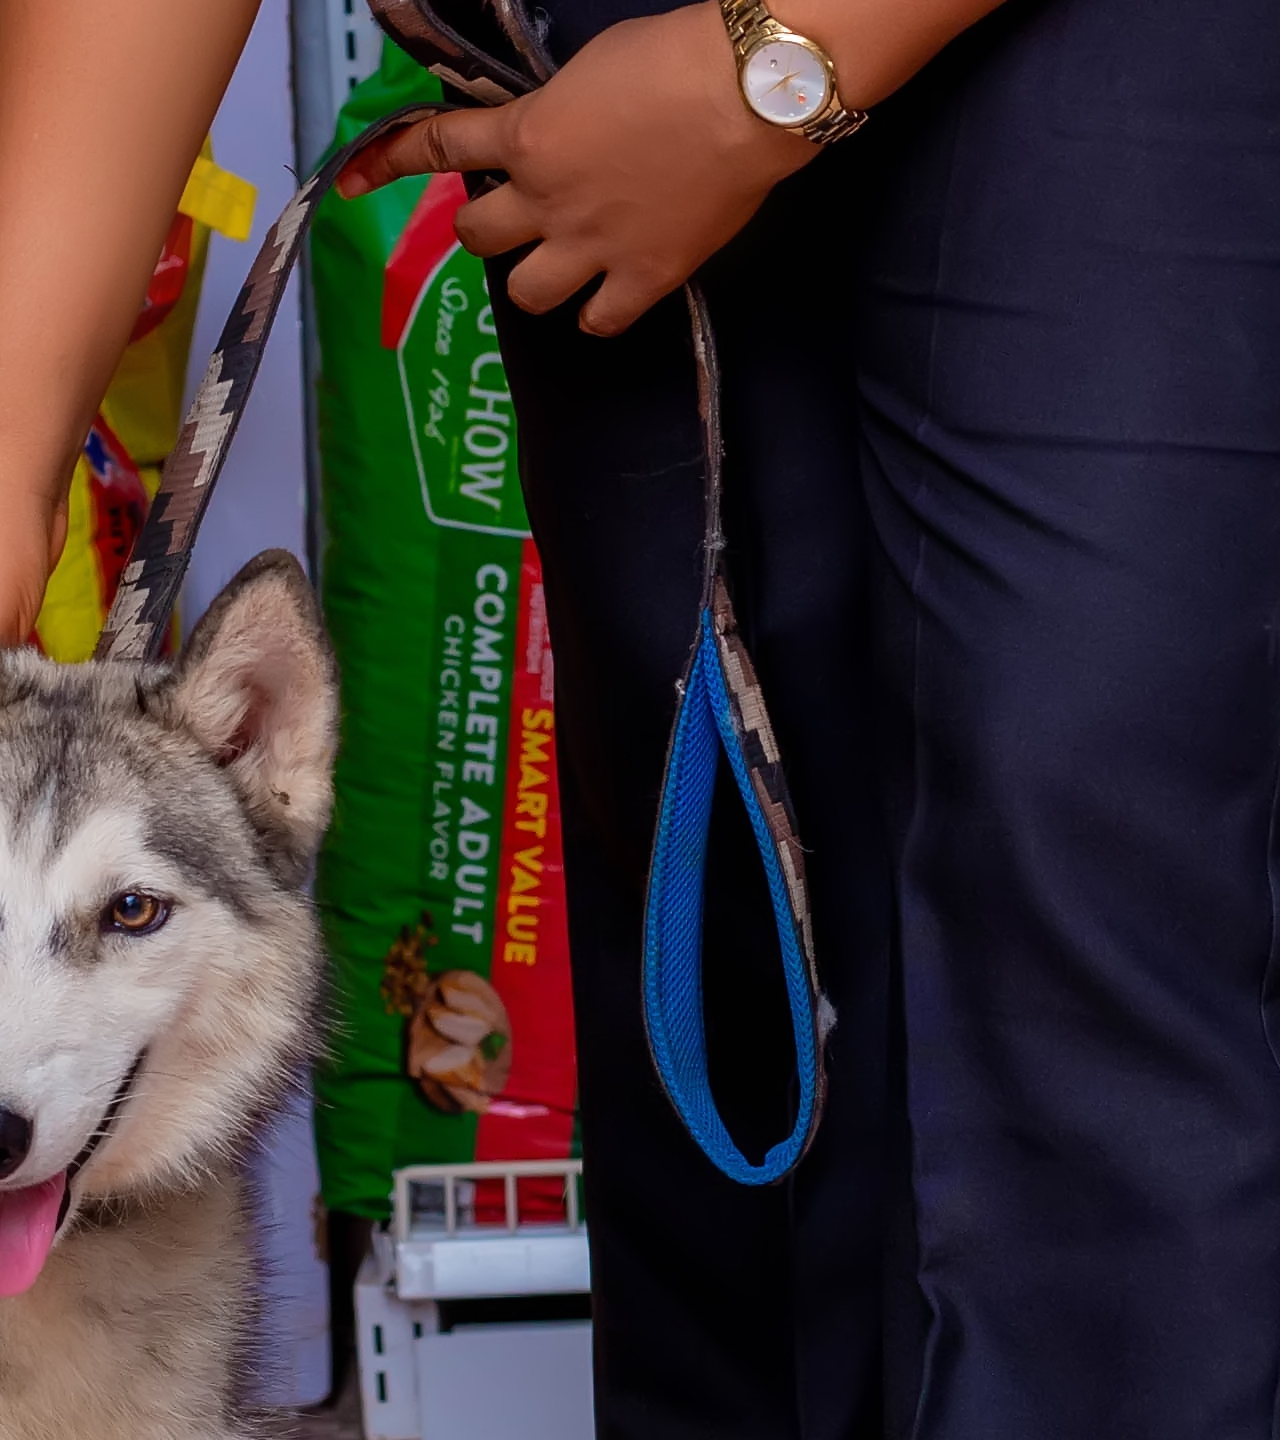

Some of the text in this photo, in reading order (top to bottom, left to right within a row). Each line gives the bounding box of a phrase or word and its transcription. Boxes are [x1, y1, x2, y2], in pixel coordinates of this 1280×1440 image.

[459, 351, 513, 513] CHOW
[427, 613, 466, 883] CHICKEN FLAVOR
[449, 560, 509, 944] COMPLETE ADULT
[515, 706, 556, 834] SMART
[503, 839, 547, 968] VALUE
